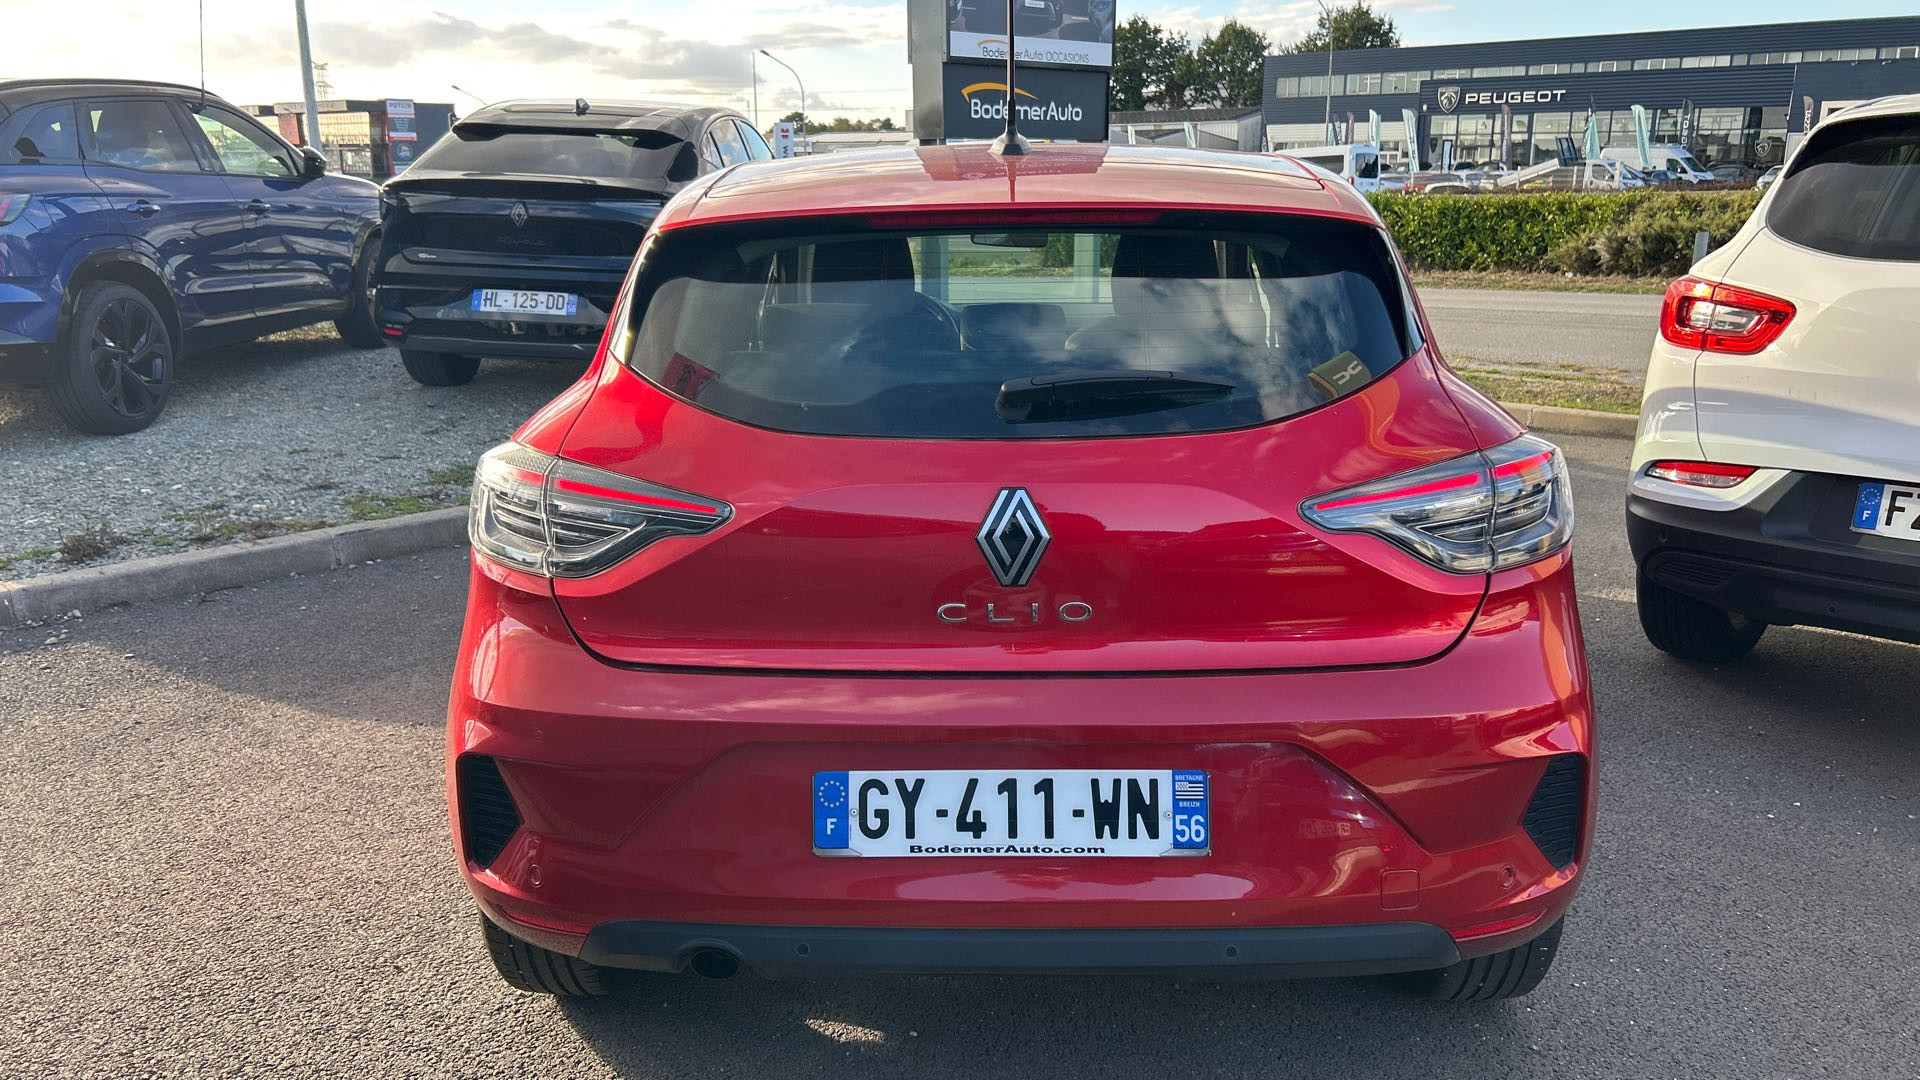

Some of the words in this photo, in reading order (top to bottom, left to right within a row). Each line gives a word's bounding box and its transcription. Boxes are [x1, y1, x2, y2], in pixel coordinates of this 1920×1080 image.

[982, 46, 1042, 61] BodeerAuto
[1046, 51, 1089, 63] OCCASIONS
[1465, 90, 1567, 105] PEUGEOT
[482, 291, 566, 311] HL-125-DD
[1862, 510, 1872, 521] F
[1885, 490, 1920, 530] F
[937, 602, 1093, 622] CLIO
[858, 778, 1160, 840] GY-411-WN
[826, 818, 837, 835] F
[1175, 814, 1205, 843] 56
[909, 844, 1105, 854] BodemerAuto.com
